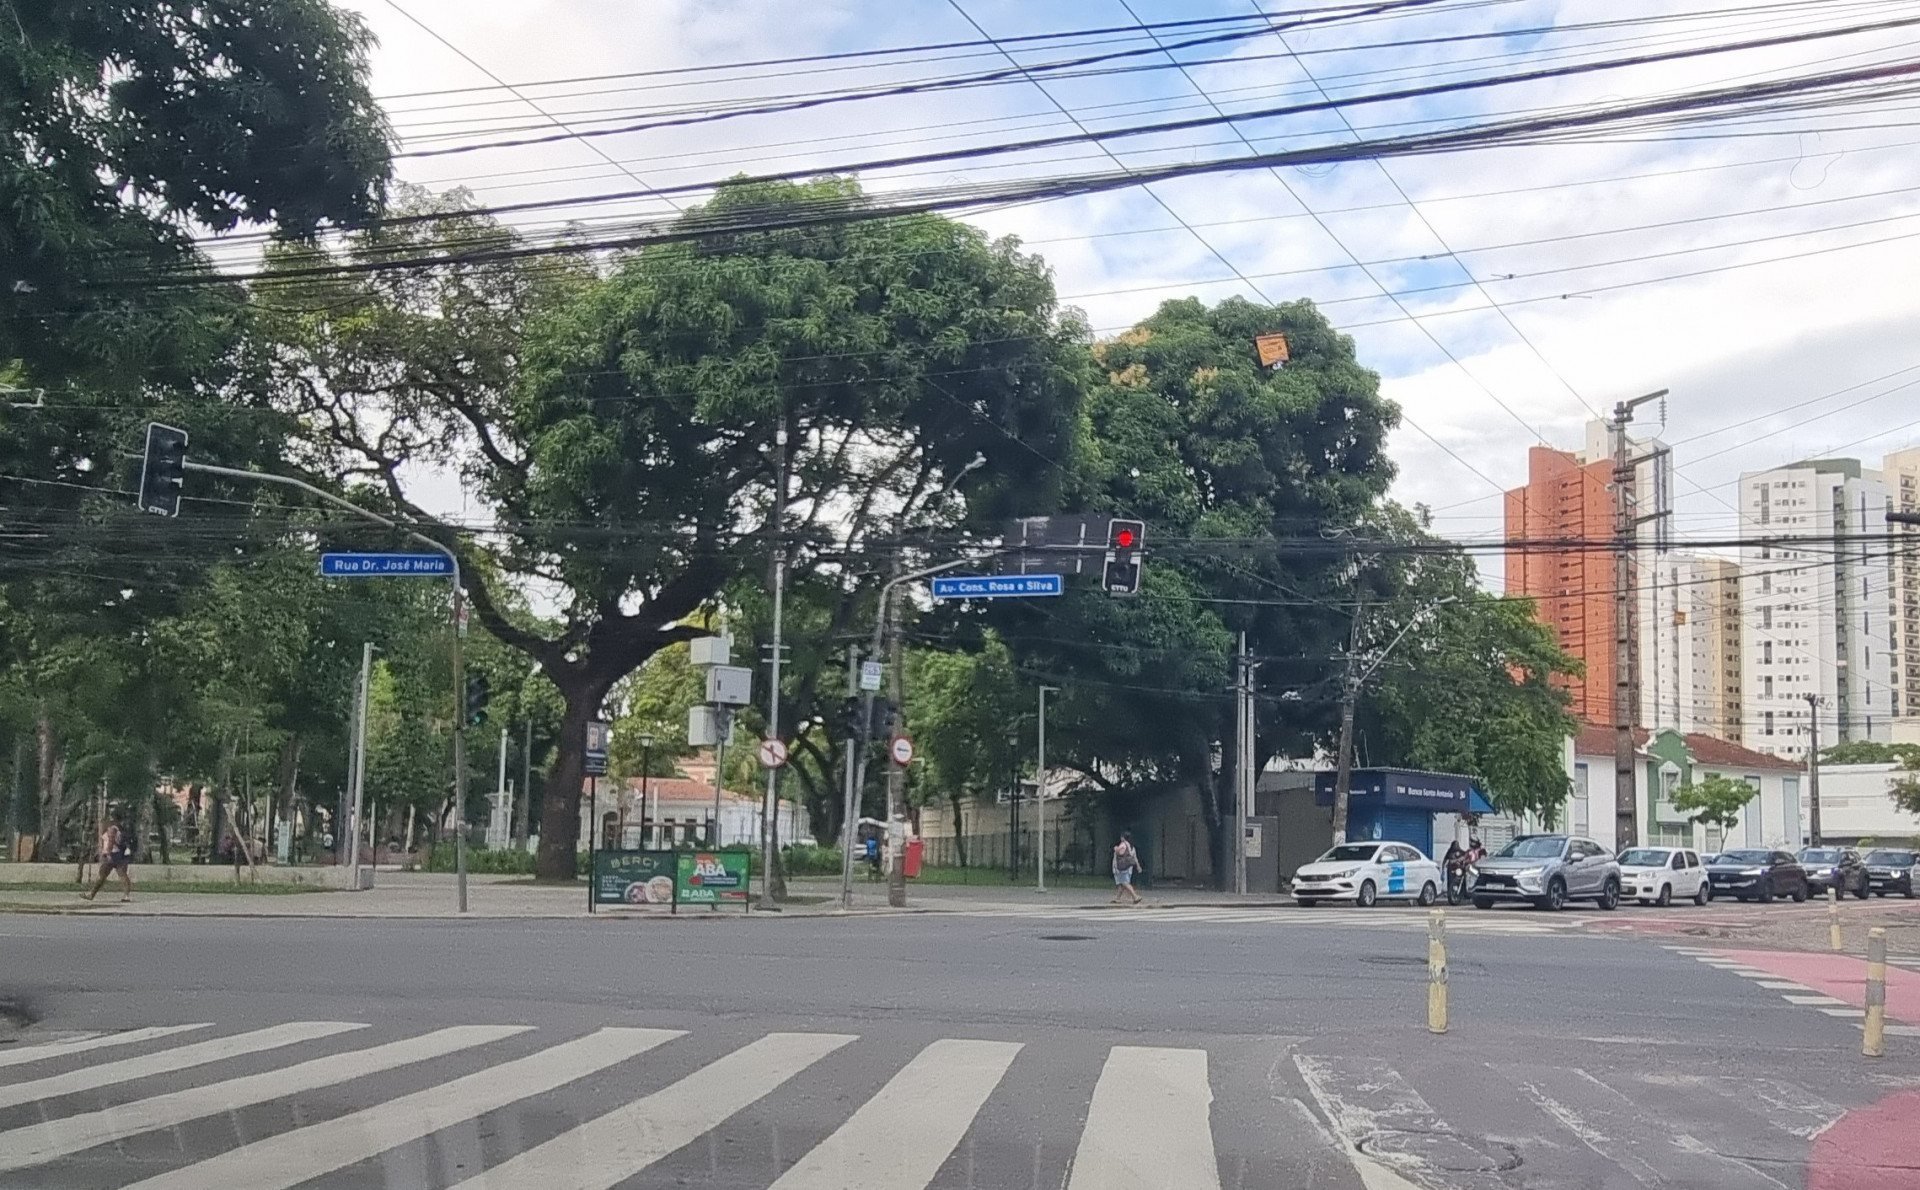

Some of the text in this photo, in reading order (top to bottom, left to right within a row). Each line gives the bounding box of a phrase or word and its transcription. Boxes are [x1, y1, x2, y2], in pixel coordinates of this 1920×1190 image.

[334, 558, 445, 571] Rua Dr. José Maria
[940, 584, 956, 593] Av.
[960, 582, 987, 593] Cons.
[989, 582, 1015, 592] Rosa
[1026, 580, 1053, 591] Silva
[693, 863, 727, 877] ABA
